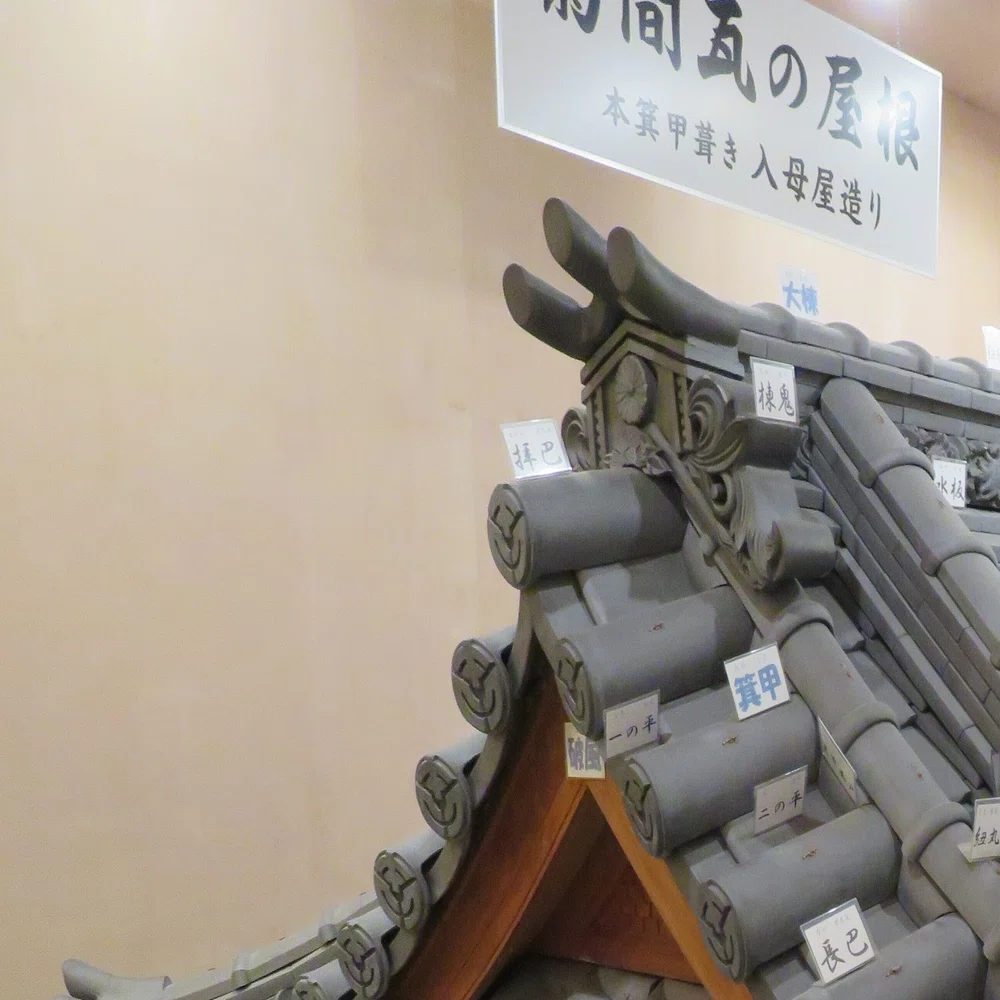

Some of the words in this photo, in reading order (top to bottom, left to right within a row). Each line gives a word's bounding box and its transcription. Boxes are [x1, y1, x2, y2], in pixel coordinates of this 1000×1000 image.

[751, 143, 881, 230] 入母屋造り
[758, 380, 794, 416] 棟鬼
[734, 664, 781, 712] 箕甲
[609, 714, 656, 741] 一の平
[758, 790, 802, 820] 二の平
